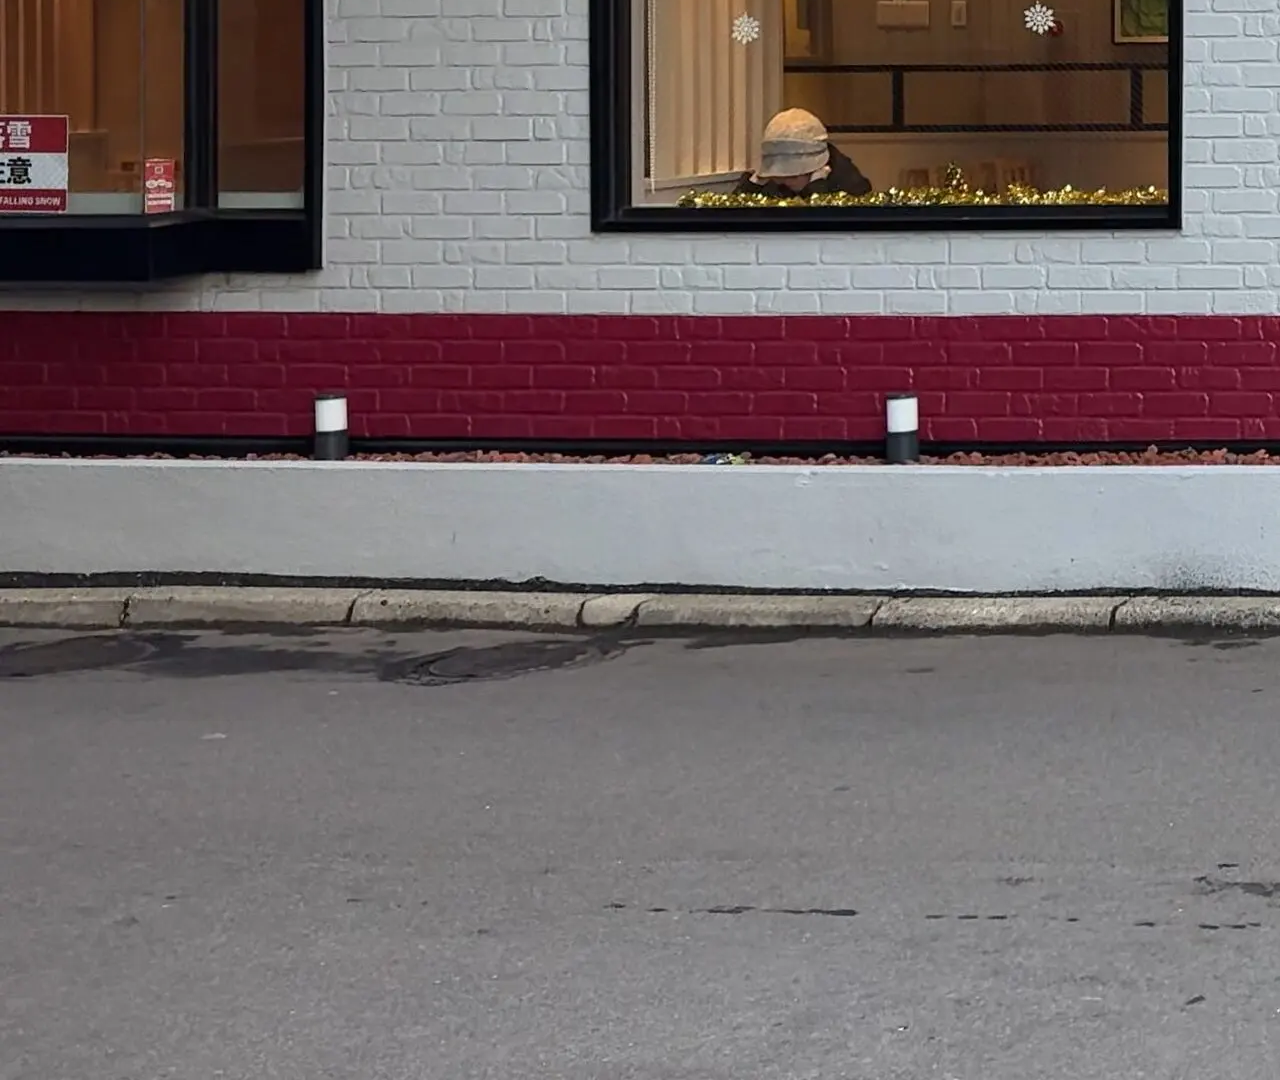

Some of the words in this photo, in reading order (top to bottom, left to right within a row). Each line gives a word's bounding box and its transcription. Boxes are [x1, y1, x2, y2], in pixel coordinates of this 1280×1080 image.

[0, 120, 32, 149] 雪
[0, 156, 32, 185] 意
[35, 196, 61, 206] SNOW
